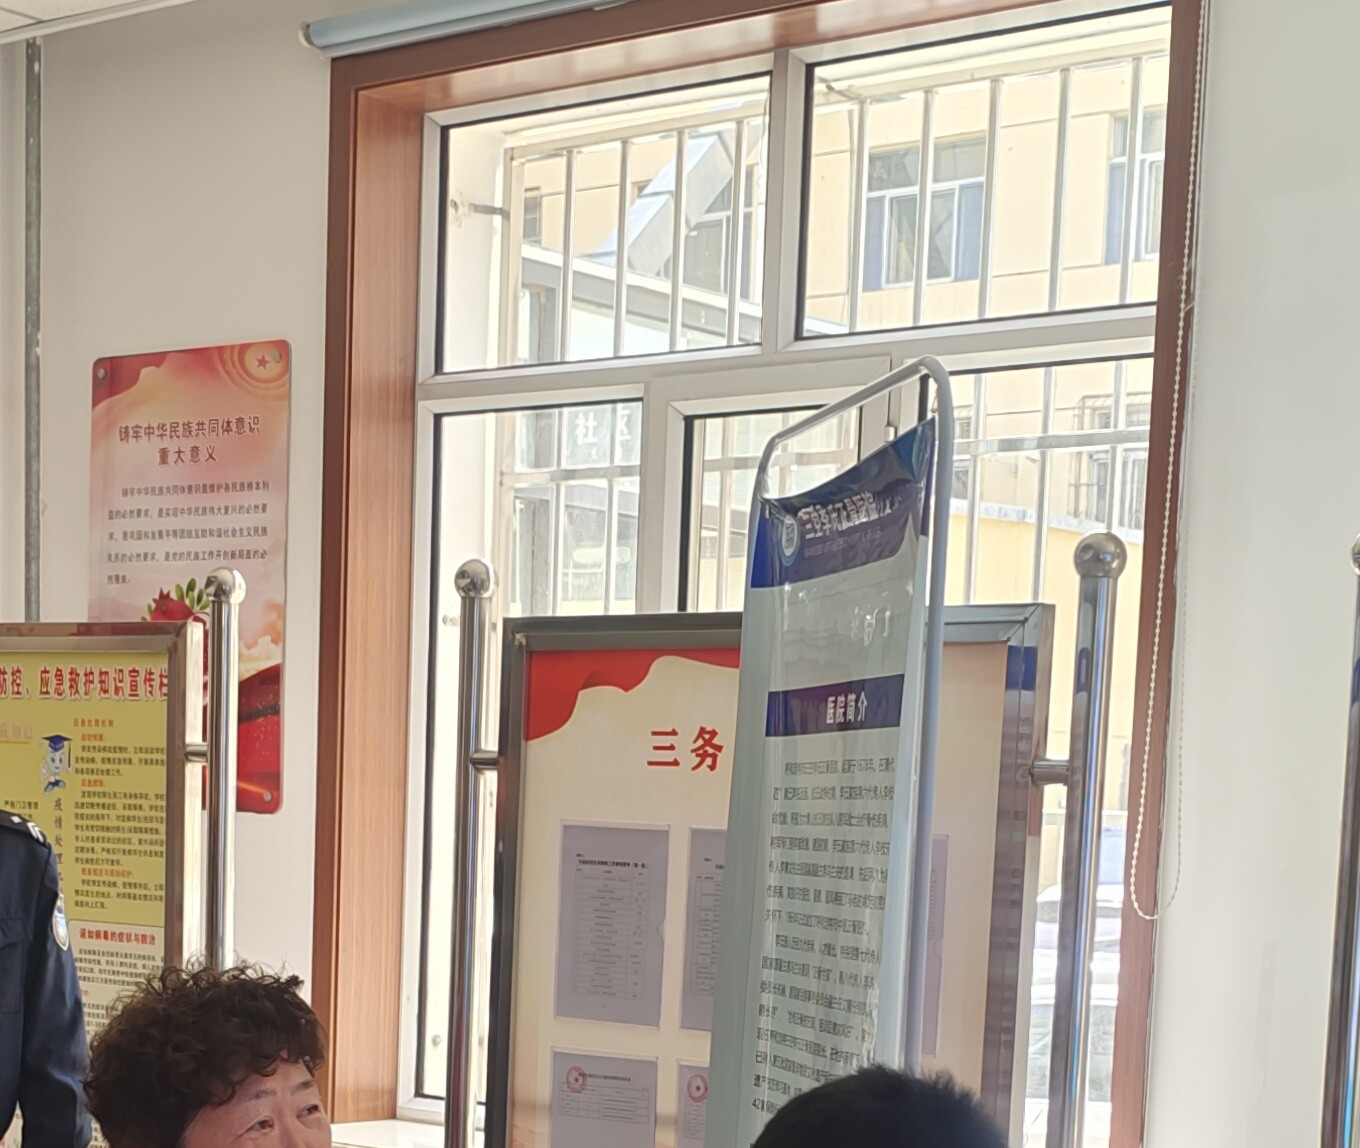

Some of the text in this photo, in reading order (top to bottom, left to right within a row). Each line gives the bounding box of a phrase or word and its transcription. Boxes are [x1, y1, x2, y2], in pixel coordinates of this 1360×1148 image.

[118, 415, 261, 443] 铸牢中华民族共同体意识
[158, 445, 217, 466] 重大意义
[826, 691, 868, 724] 医院简介
[646, 726, 724, 772] 三务
